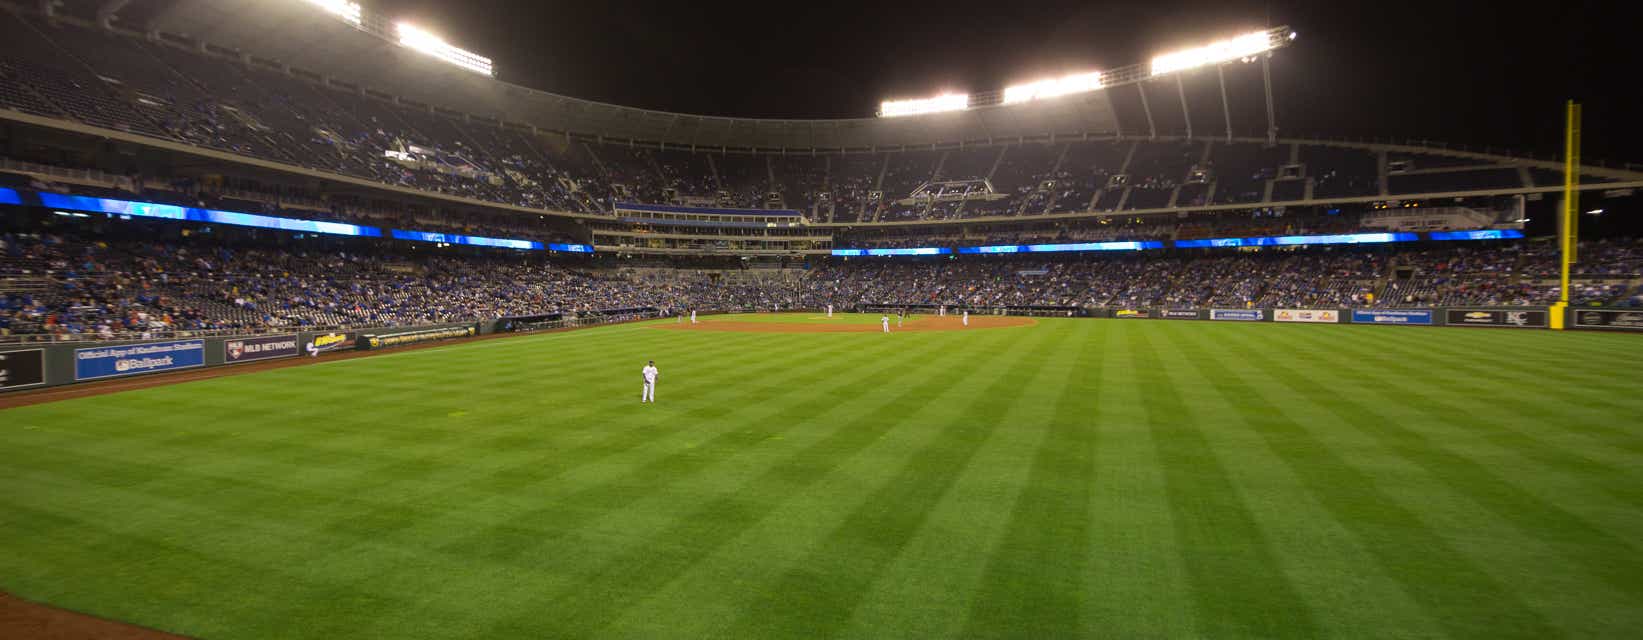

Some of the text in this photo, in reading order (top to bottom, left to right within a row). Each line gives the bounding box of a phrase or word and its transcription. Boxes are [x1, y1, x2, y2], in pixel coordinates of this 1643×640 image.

[245, 340, 297, 353] MLB NETWORK
[129, 356, 173, 369] Ballpark
